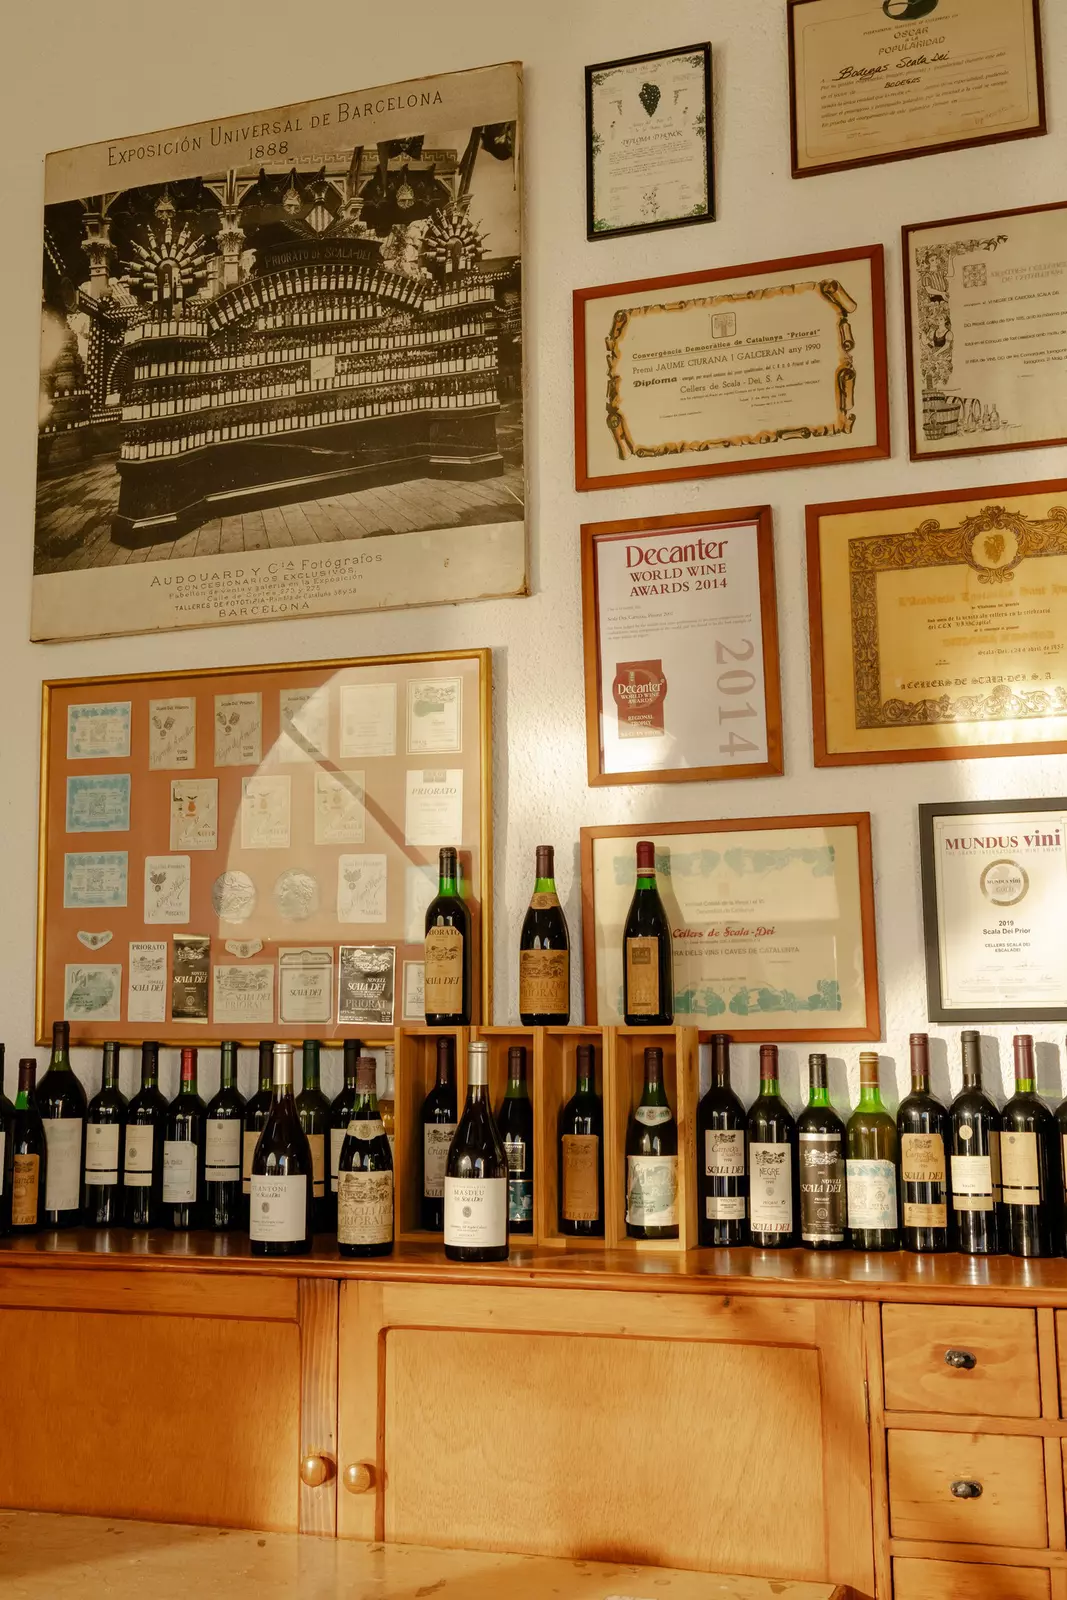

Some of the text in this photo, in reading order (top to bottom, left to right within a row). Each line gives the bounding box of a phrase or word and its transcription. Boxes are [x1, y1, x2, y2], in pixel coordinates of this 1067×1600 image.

[894, 27, 929, 39] OSCAR
[878, 36, 946, 55] POPULARIDAD
[108, 91, 443, 166] EXPOSICIÓN UNIVERSAL DE BARCELONA
[249, 141, 288, 160] 1888
[746, 335, 782, 344] Catalunya
[632, 366, 653, 374] Premi
[656, 360, 684, 371] JAUME
[688, 356, 728, 366] CIURANA
[737, 347, 784, 360] GALCERAN
[789, 346, 802, 354] any
[806, 343, 821, 351] 1990
[633, 376, 678, 388] Diploma
[680, 385, 706, 394] Cellers
[722, 380, 740, 388] Scala
[626, 538, 728, 568] Decanter
[150, 570, 244, 587] AUDOUARD
[252, 568, 260, 576] Y
[302, 553, 382, 570] Fotógrafos
[630, 562, 727, 583] WORLD WINE
[177, 576, 278, 592] CONCESIONARIOS
[630, 578, 728, 598] AWARDS 2014
[175, 602, 210, 612] TALLERES
[218, 602, 310, 618] BARCELONA
[618, 682, 662, 694] Decanter
[714, 638, 760, 758] 2014
[412, 787, 457, 795] PRIORATO
[944, 828, 1062, 850] MUNDUS vini
[672, 928, 704, 938] Cellers
[708, 928, 720, 938] de
[444, 976, 460, 984] DEI
[347, 982, 386, 991] SCALA DEI
[346, 1000, 388, 1008] PRIORAT
[706, 1166, 744, 1174] SCALA DEI
[760, 1168, 780, 1178] NEGRE
[904, 1172, 944, 1180] SCALA DEI
[801, 1184, 842, 1193] SCALA DEI
[752, 1223, 791, 1231] SCALA DEI
